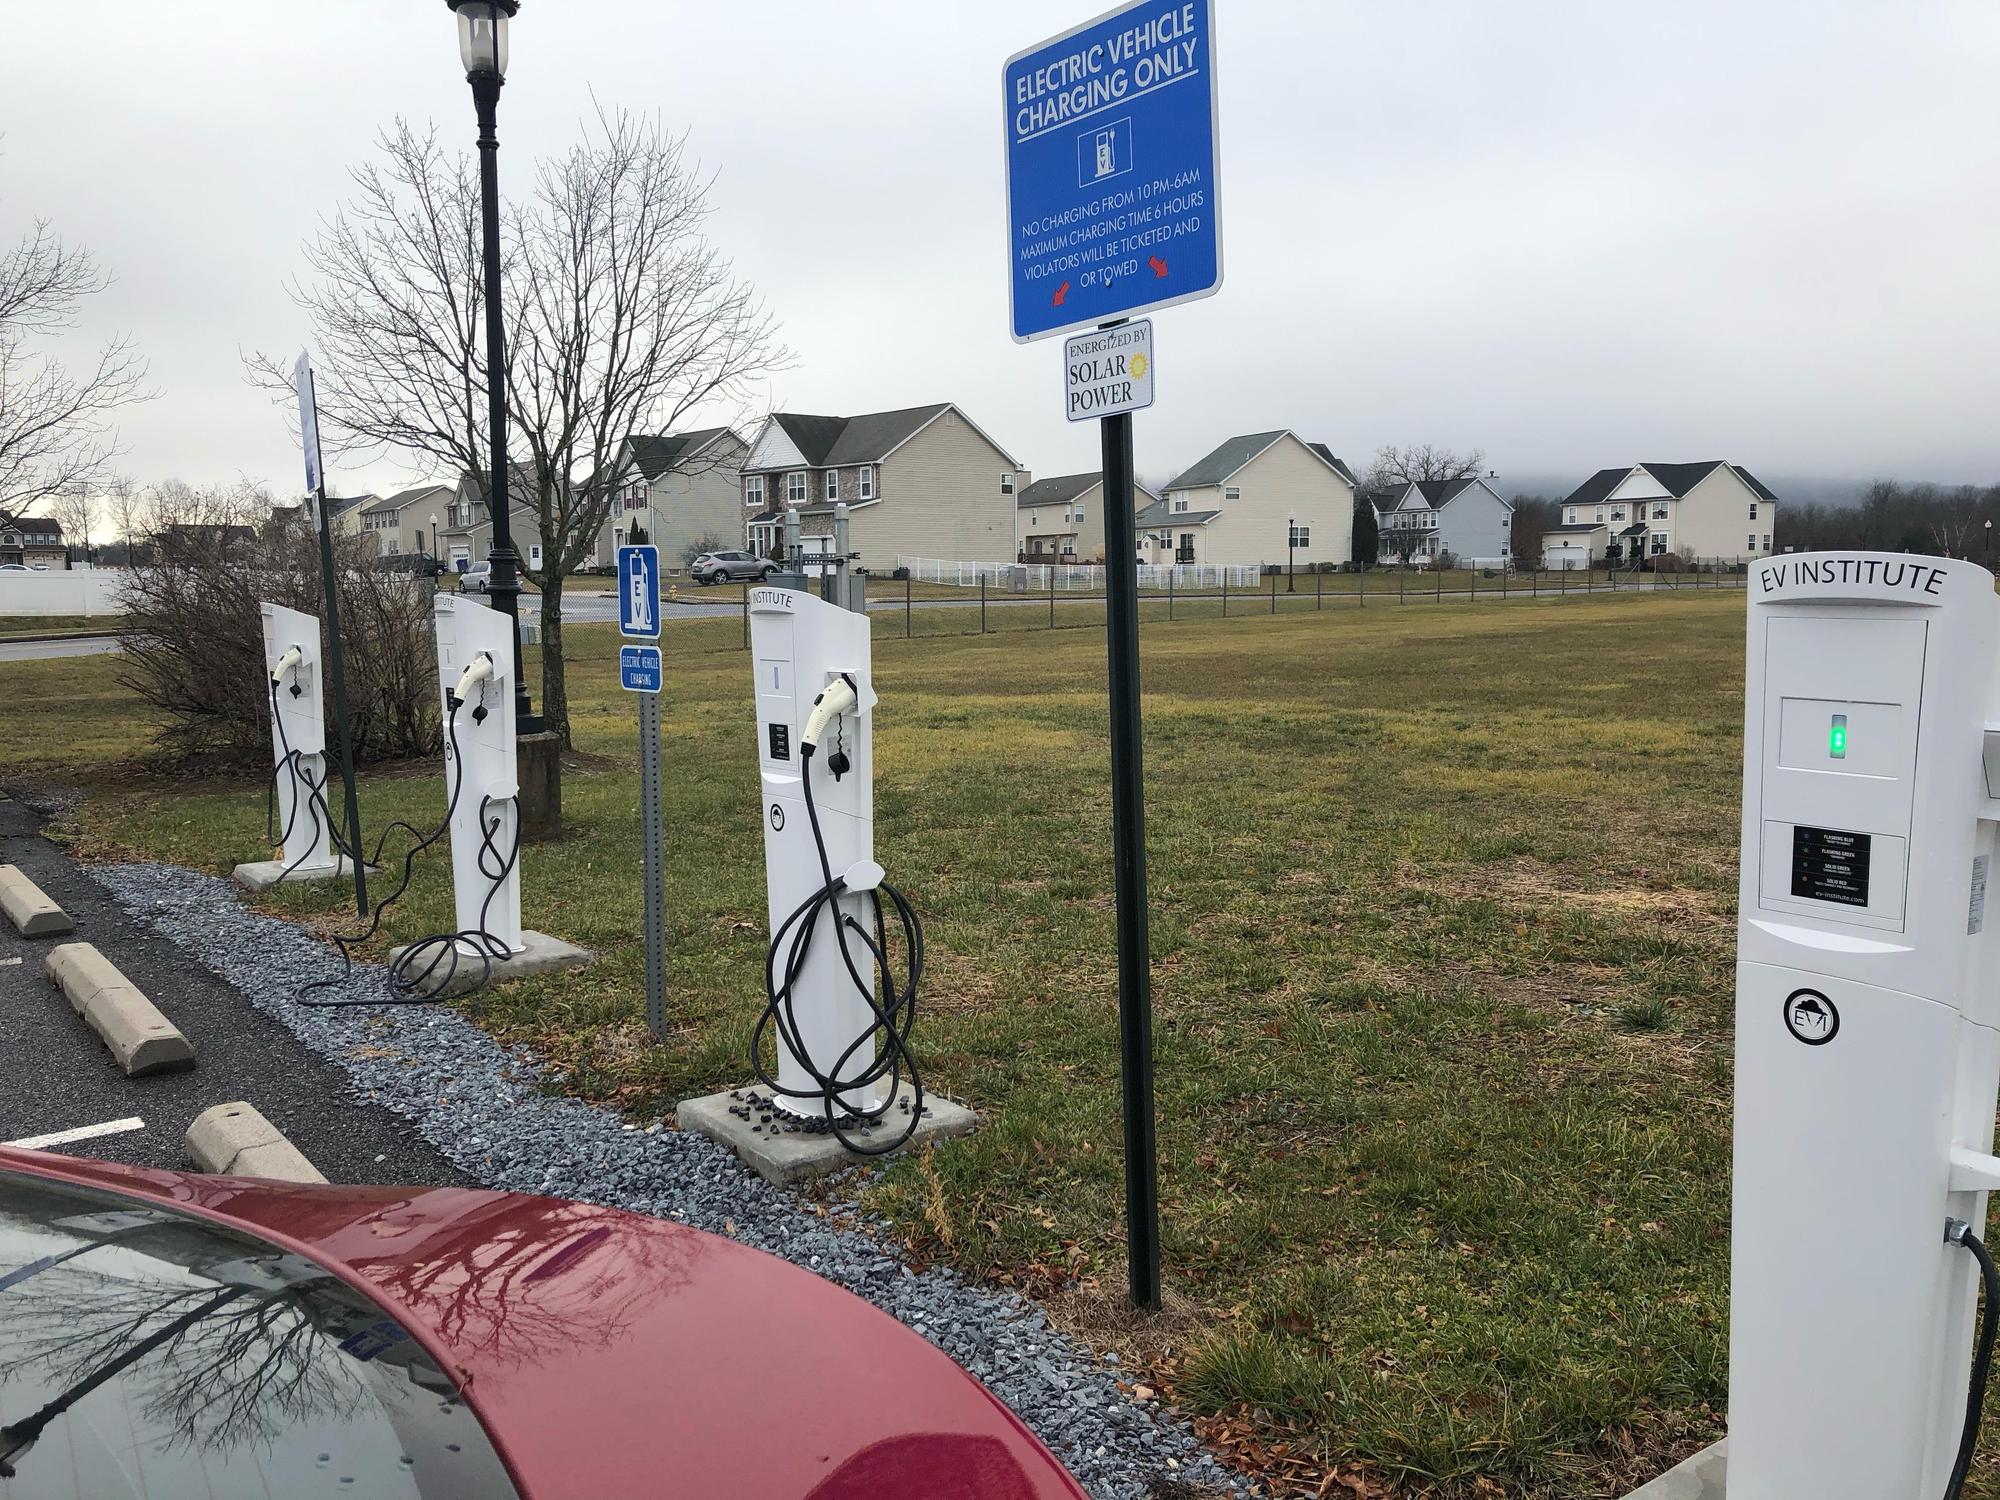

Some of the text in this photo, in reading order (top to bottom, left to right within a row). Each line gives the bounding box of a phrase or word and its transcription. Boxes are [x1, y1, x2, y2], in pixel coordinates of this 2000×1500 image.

[1016, 3, 1195, 104] ELECTRIC VEHICLE
[1016, 37, 1197, 135] CHARGING ONLY
[1022, 167, 1200, 239] NO CHARGING FROM 10 PM-6AM
[1020, 190, 1204, 261] MAXIMUM CHARGING TIME 6 HOURS
[1024, 217, 1200, 281] VIOLATORS WILL BE TICKETED AND
[1080, 259, 1138, 288] OR TOWED
[1070, 328, 1147, 358] ENERGIZED BY
[1070, 355, 1126, 385] SOLAR
[1071, 381, 1133, 413] POWER
[1761, 560, 1948, 595] EV INSTITUTE
[634, 581, 642, 618] EV
[752, 591, 793, 609] NSTITUTE
[1815, 891, 1865, 903] ev-institute.com
